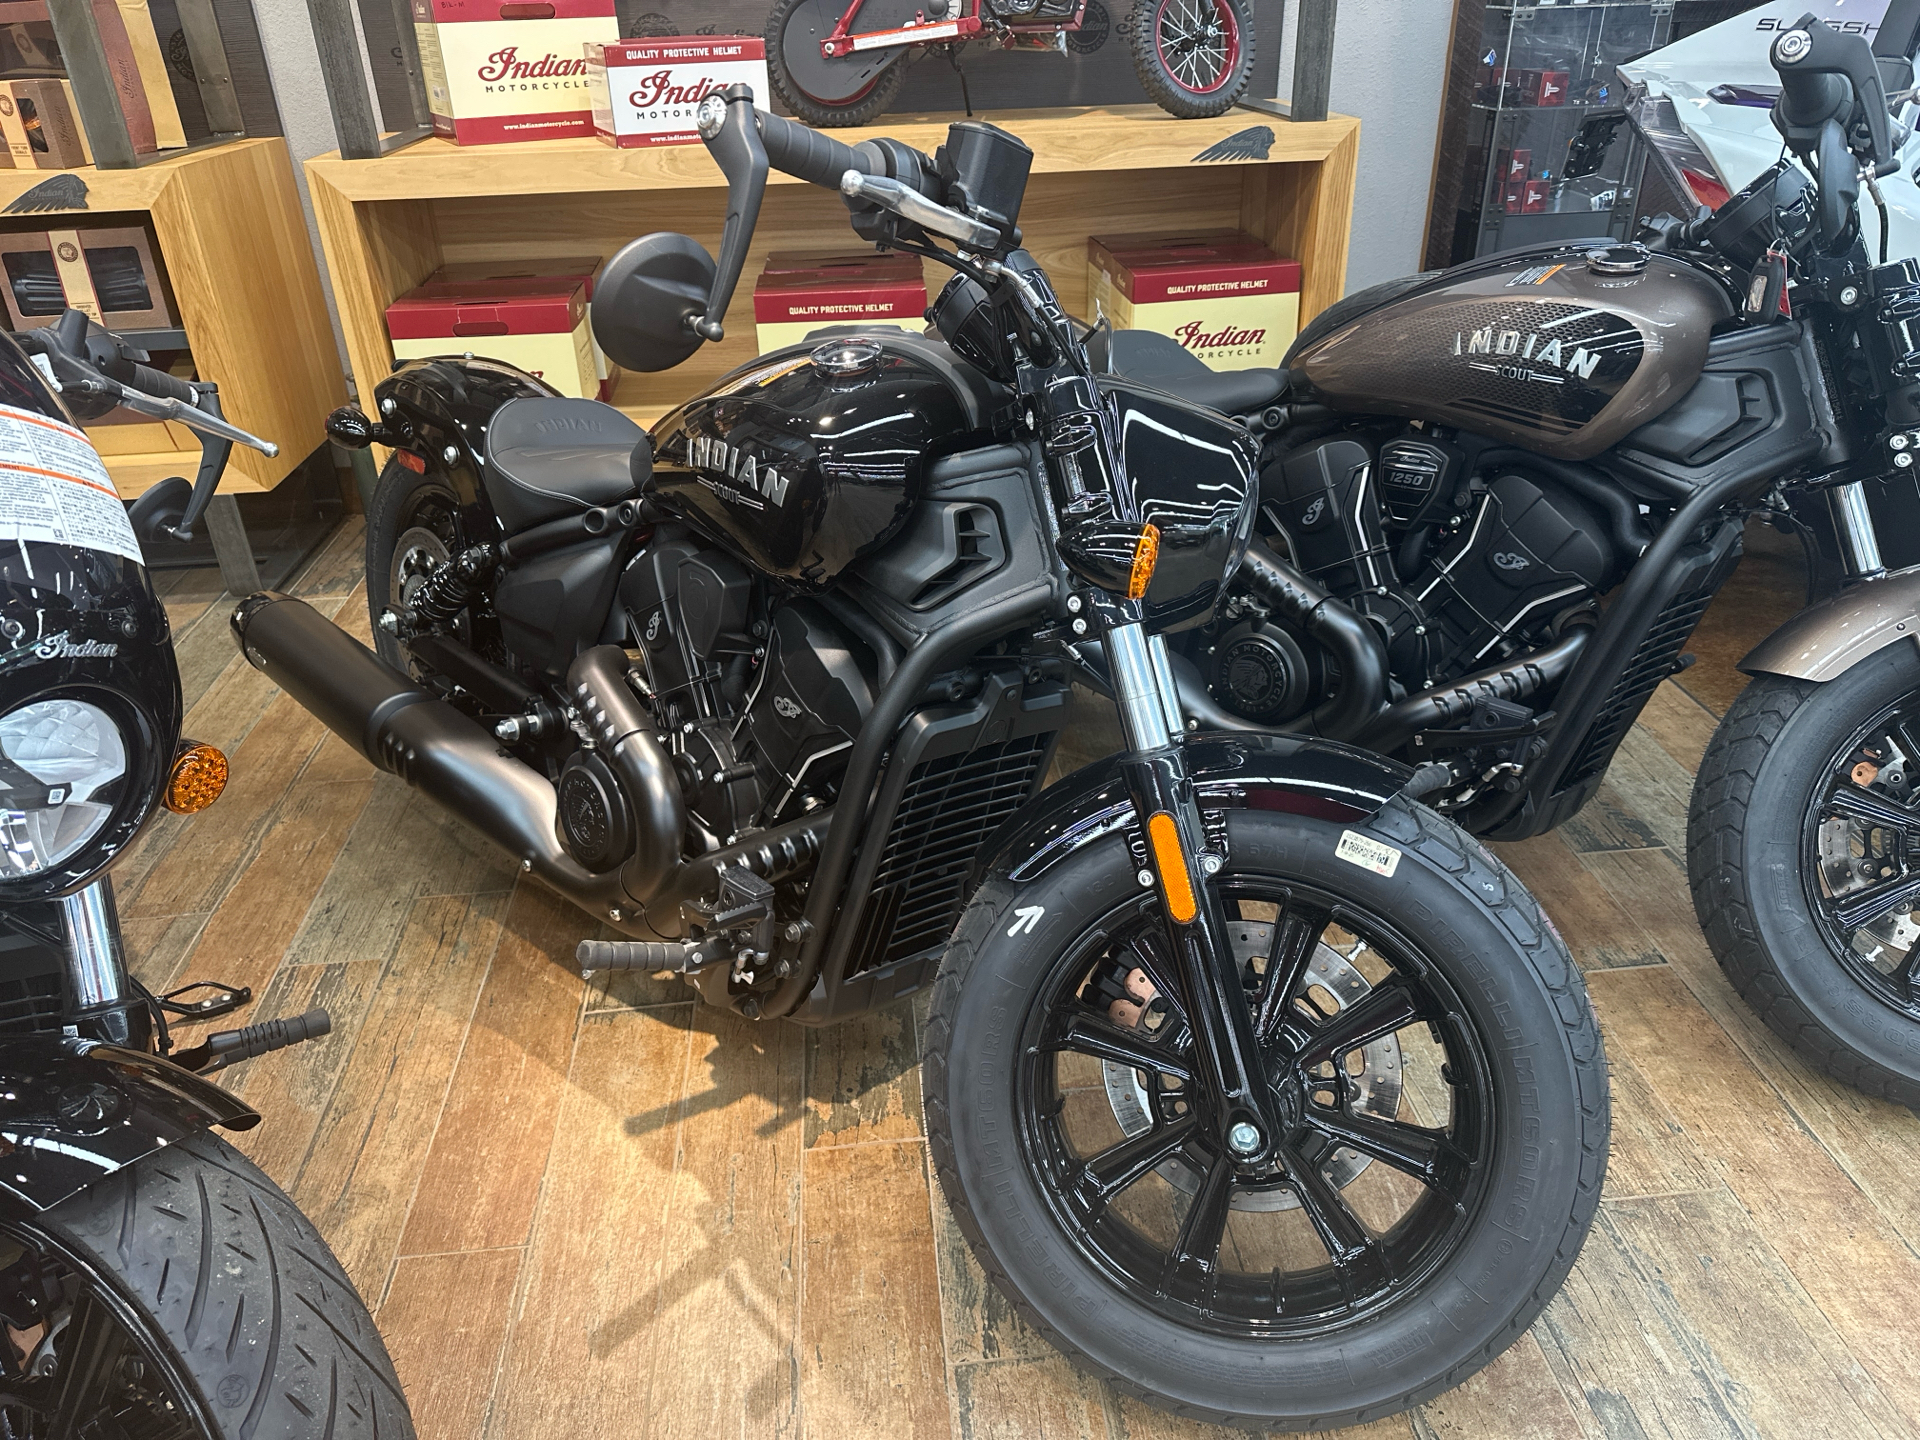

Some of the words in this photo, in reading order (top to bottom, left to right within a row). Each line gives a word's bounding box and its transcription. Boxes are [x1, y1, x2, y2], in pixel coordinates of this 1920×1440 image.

[1756, 18, 1880, 35] SLGSH
[625, 49, 660, 60] QUALITY
[663, 47, 710, 59] PROTECTIVE
[713, 45, 743, 56] HELMET
[478, 46, 588, 82] Indian
[485, 81, 590, 94] MOTORCYCLE
[629, 70, 744, 108] Indi
[636, 108, 693, 120] MOTOR
[503, 119, 585, 131] www.indianmotorcycle.com
[1167, 284, 1196, 295] QUALITY
[1197, 282, 1240, 293] PROTECTIVE
[1240, 279, 1269, 289] HELMET
[788, 306, 819, 316] QUALITY
[820, 304, 862, 316] PROTECTIVE
[862, 303, 894, 314] HELMET
[1173, 320, 1266, 350] Indian
[1196, 347, 1262, 360] ORCYCLE
[1452, 329, 1602, 381] INDIAN
[1495, 364, 1534, 382] SCOUT
[686, 436, 790, 508] INDIAN
[1389, 471, 1424, 486] 1250
[713, 480, 741, 506] SCOUT
[36, 630, 118, 660] Indian
